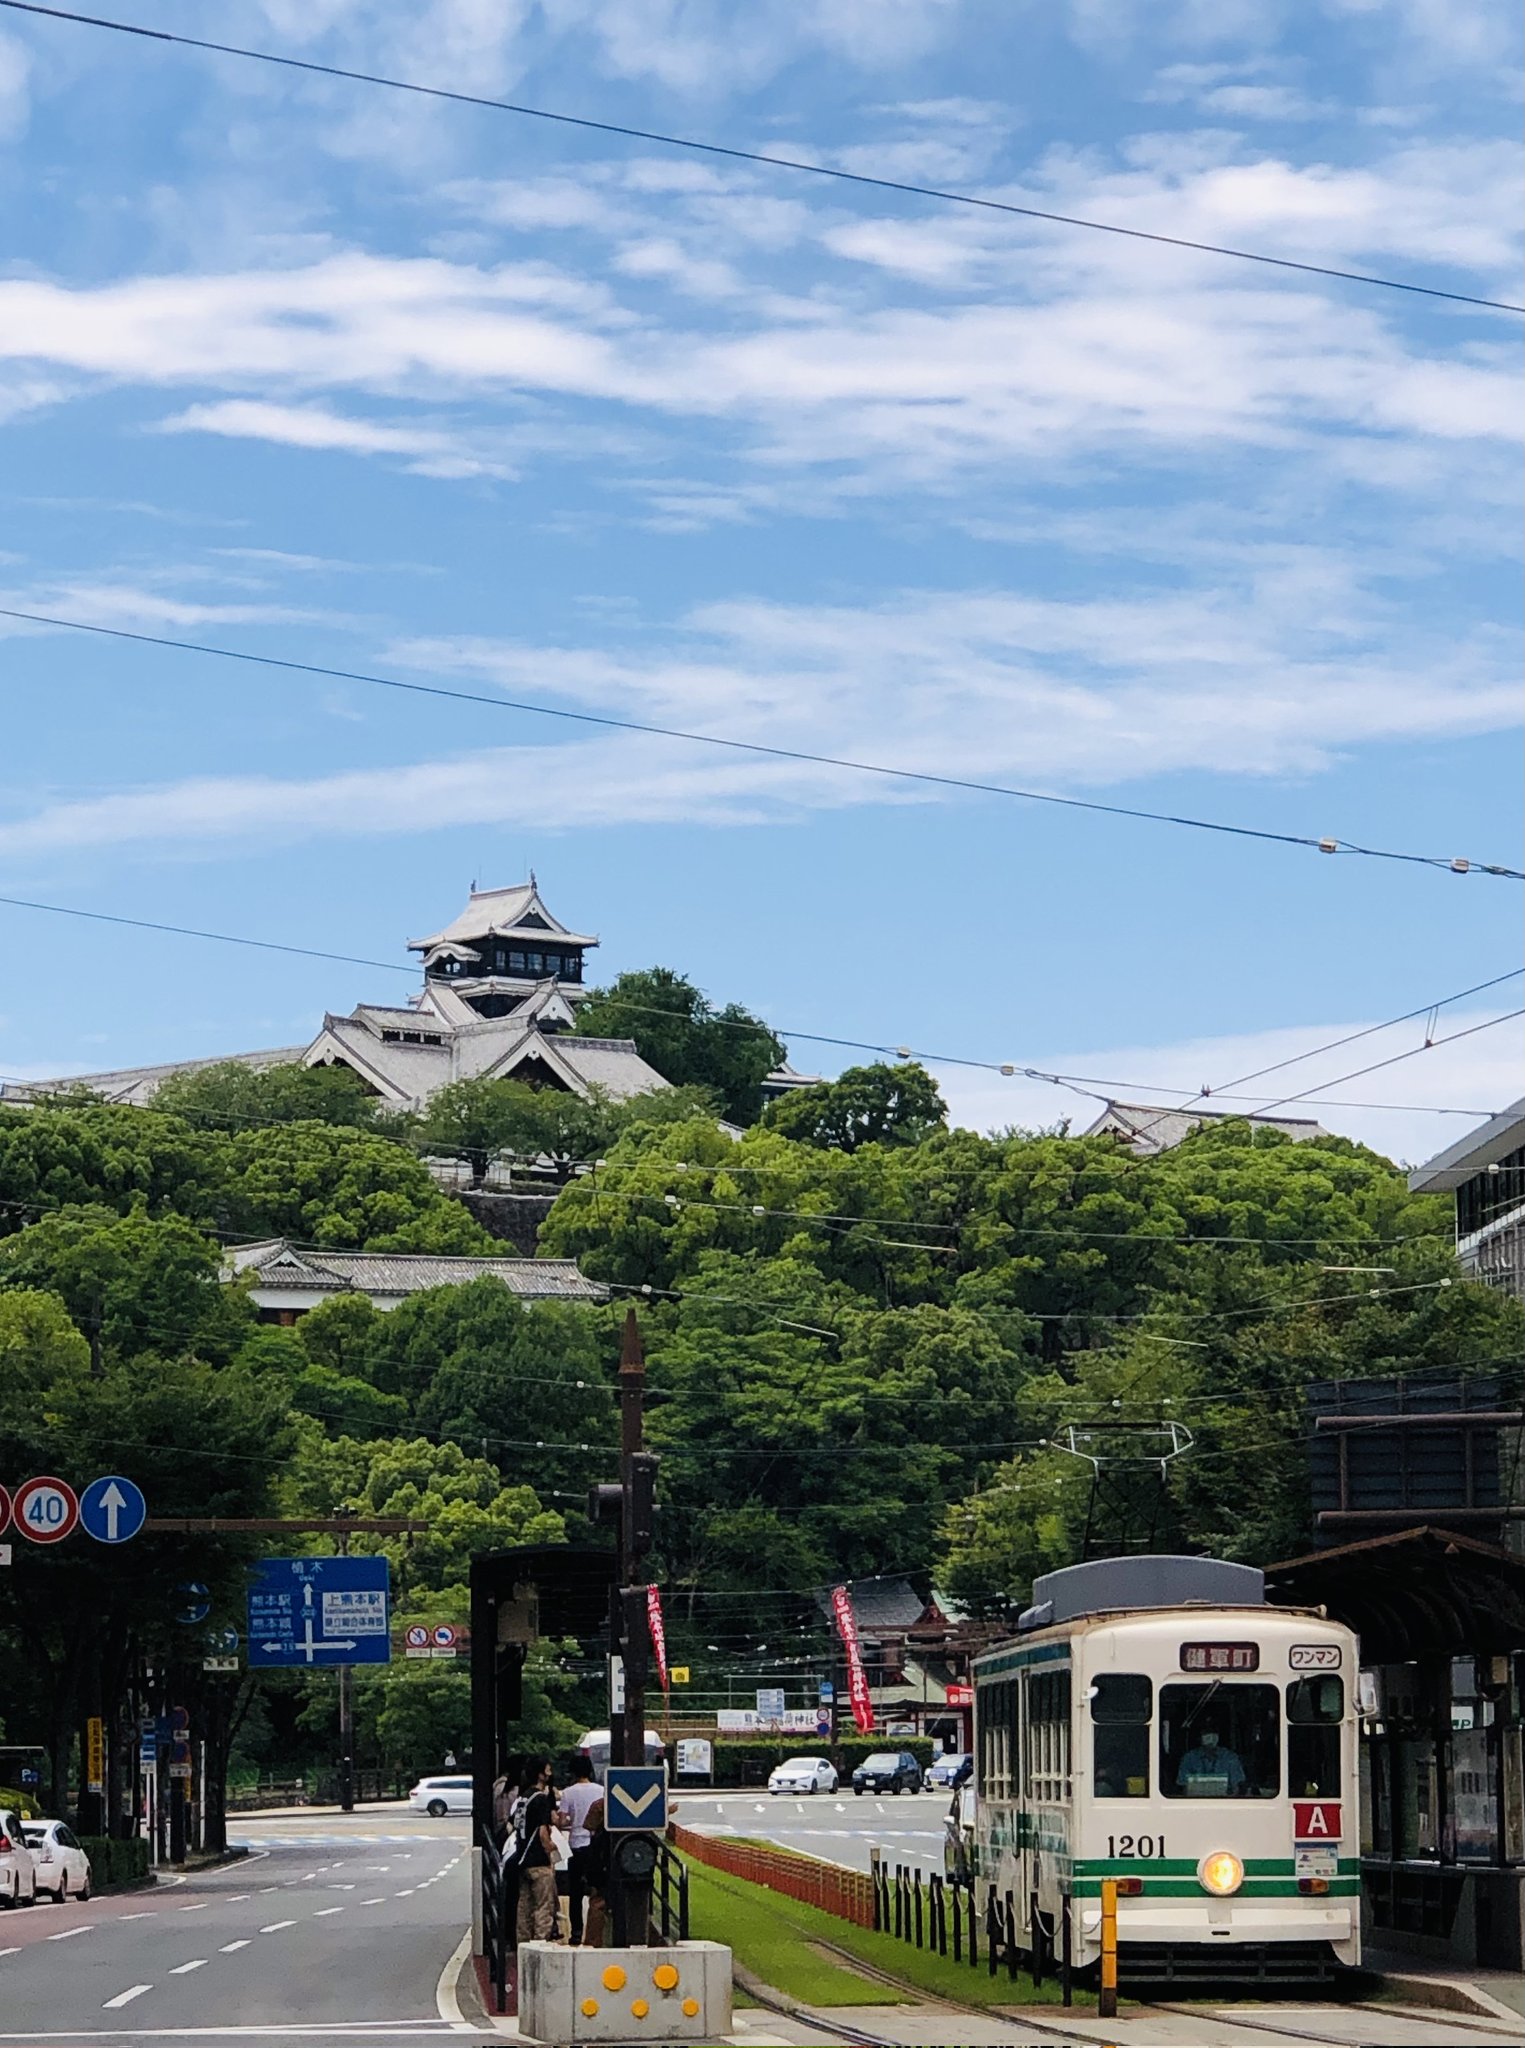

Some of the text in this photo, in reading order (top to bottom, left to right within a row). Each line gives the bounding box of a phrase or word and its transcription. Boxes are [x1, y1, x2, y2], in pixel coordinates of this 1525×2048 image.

[28, 1496, 63, 1524] 40
[251, 1594, 291, 1607] 熊本駅
[328, 1594, 380, 1606] 上熊本駅
[1186, 1648, 1253, 1668] 健軍町
[1292, 1651, 1338, 1665] ワンマン
[1307, 1806, 1328, 1834] A
[1107, 1835, 1166, 1858] 1201
